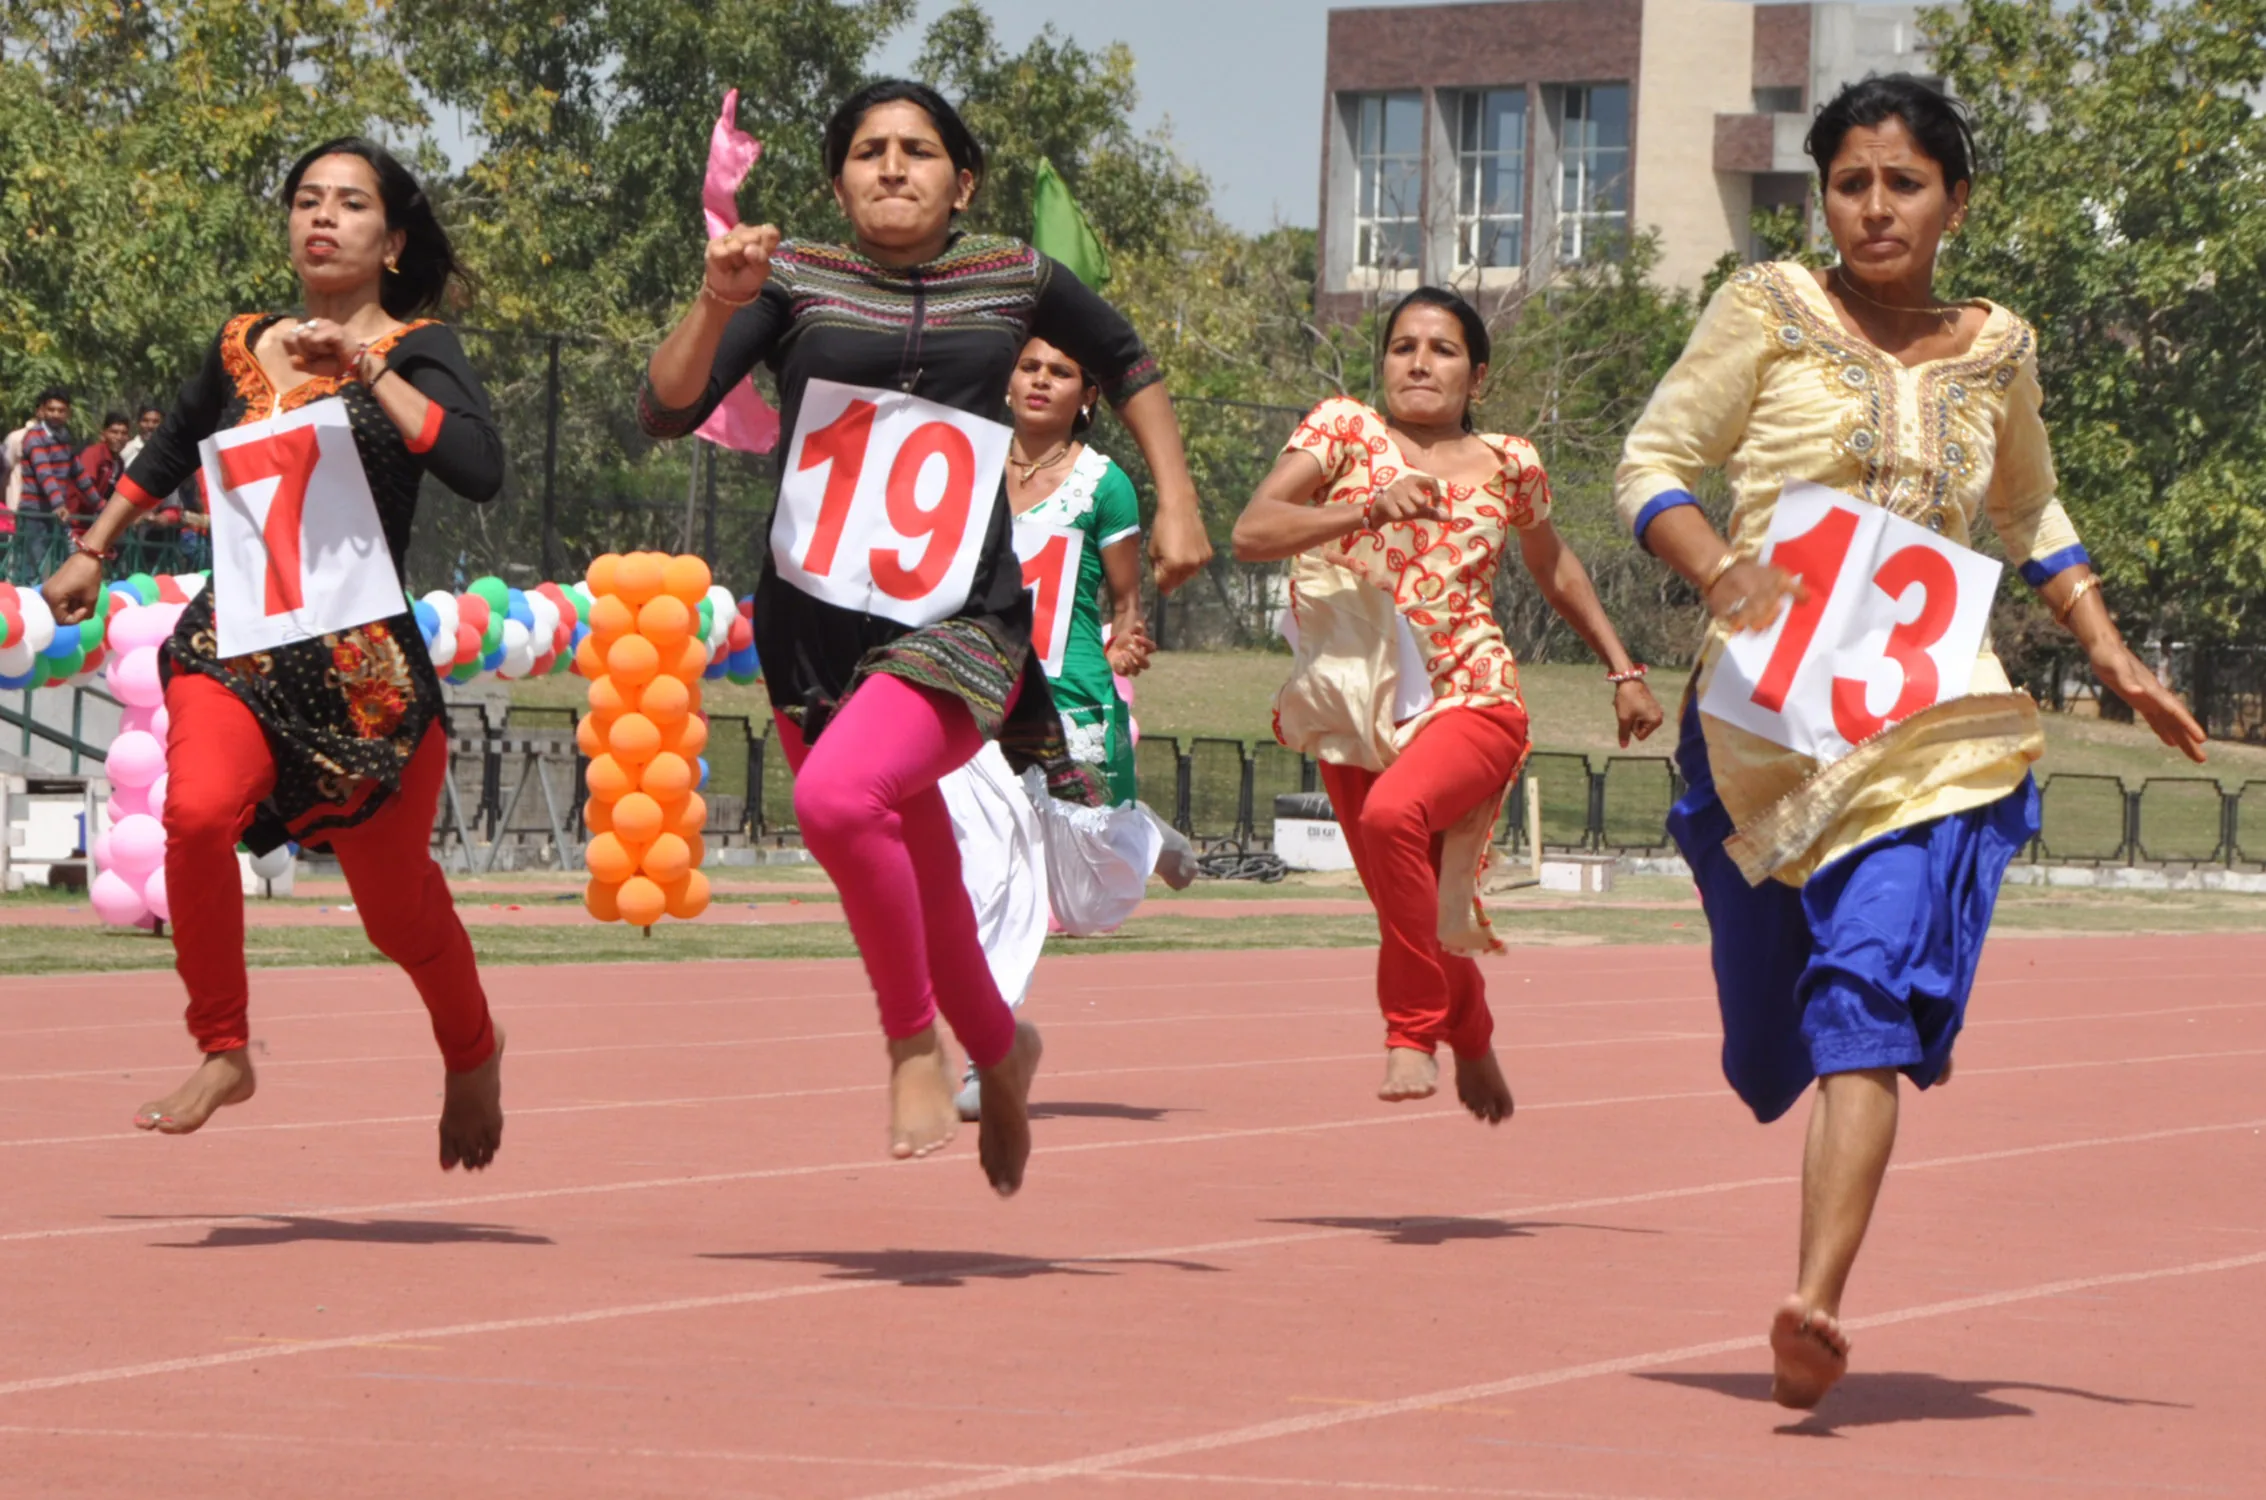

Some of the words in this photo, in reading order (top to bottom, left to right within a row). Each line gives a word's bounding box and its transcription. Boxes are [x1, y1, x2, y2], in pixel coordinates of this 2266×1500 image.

[218, 424, 320, 617] 7
[797, 398, 976, 602] 19
[1751, 506, 1958, 748] 13
